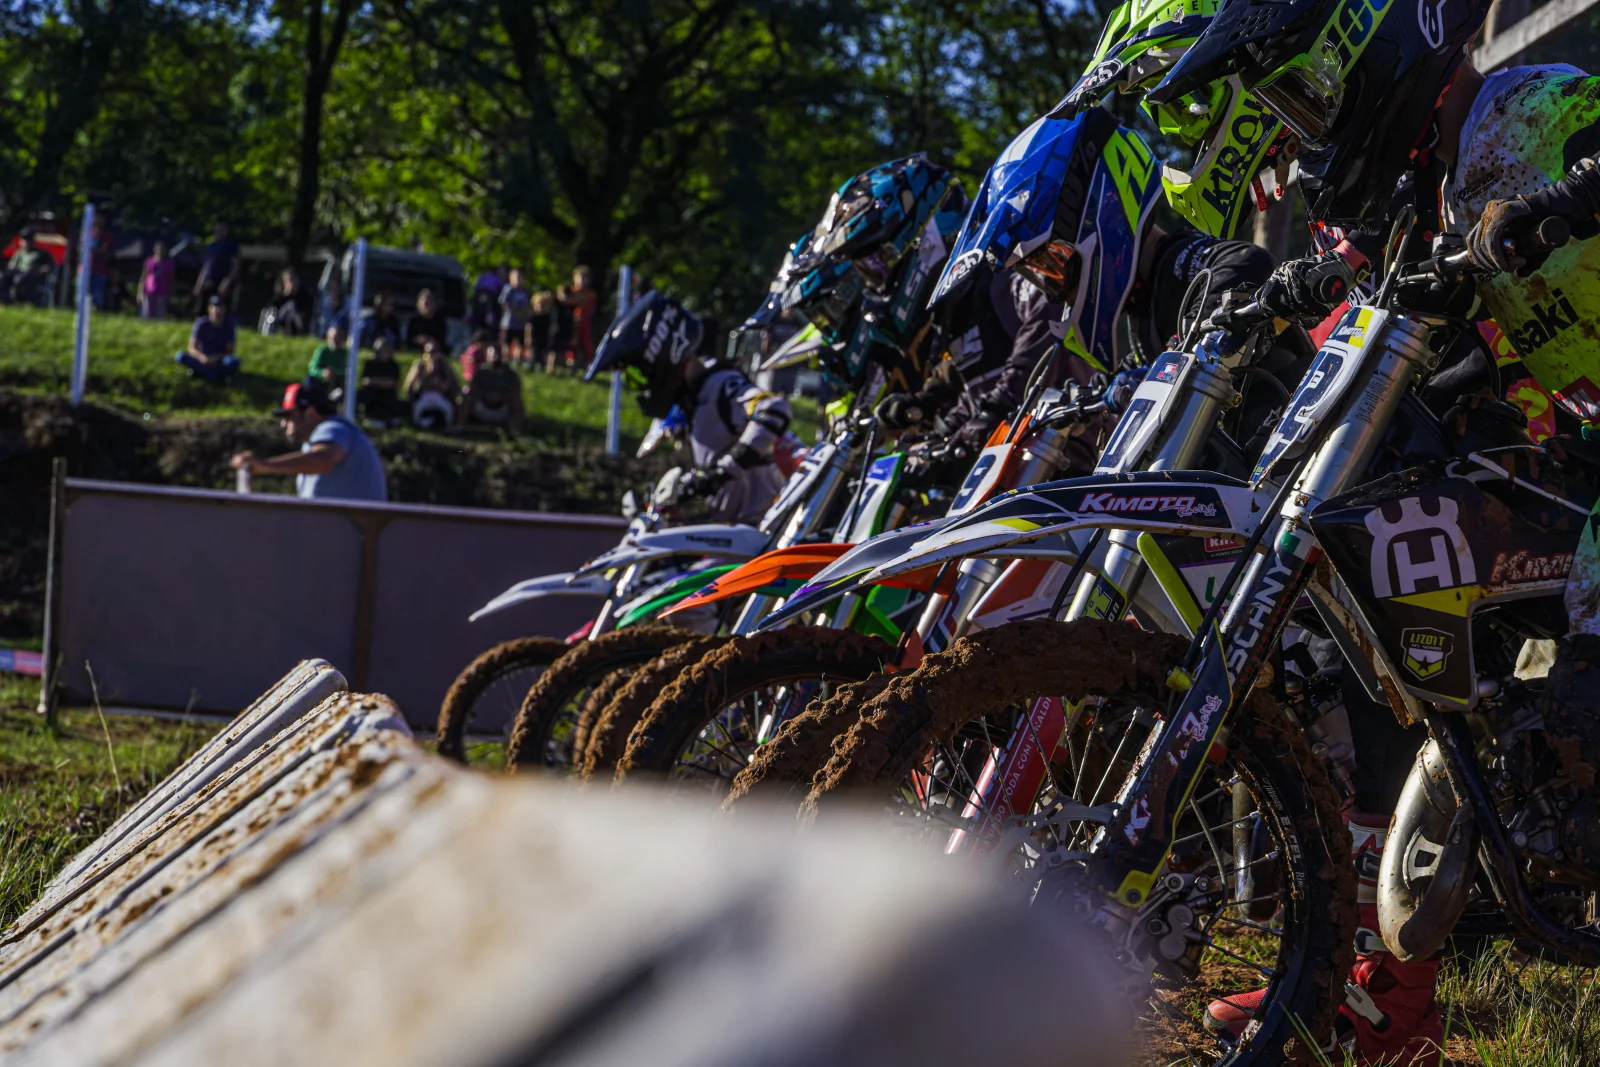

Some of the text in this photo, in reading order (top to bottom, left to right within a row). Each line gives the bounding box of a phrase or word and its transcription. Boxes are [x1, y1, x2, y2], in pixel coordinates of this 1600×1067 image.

[1051, 141, 1098, 241] 00%
[642, 305, 678, 362] 100%
[1507, 287, 1579, 358] saki
[1078, 492, 1197, 512] KIMOTO
[1016, 744, 1032, 770] COM
